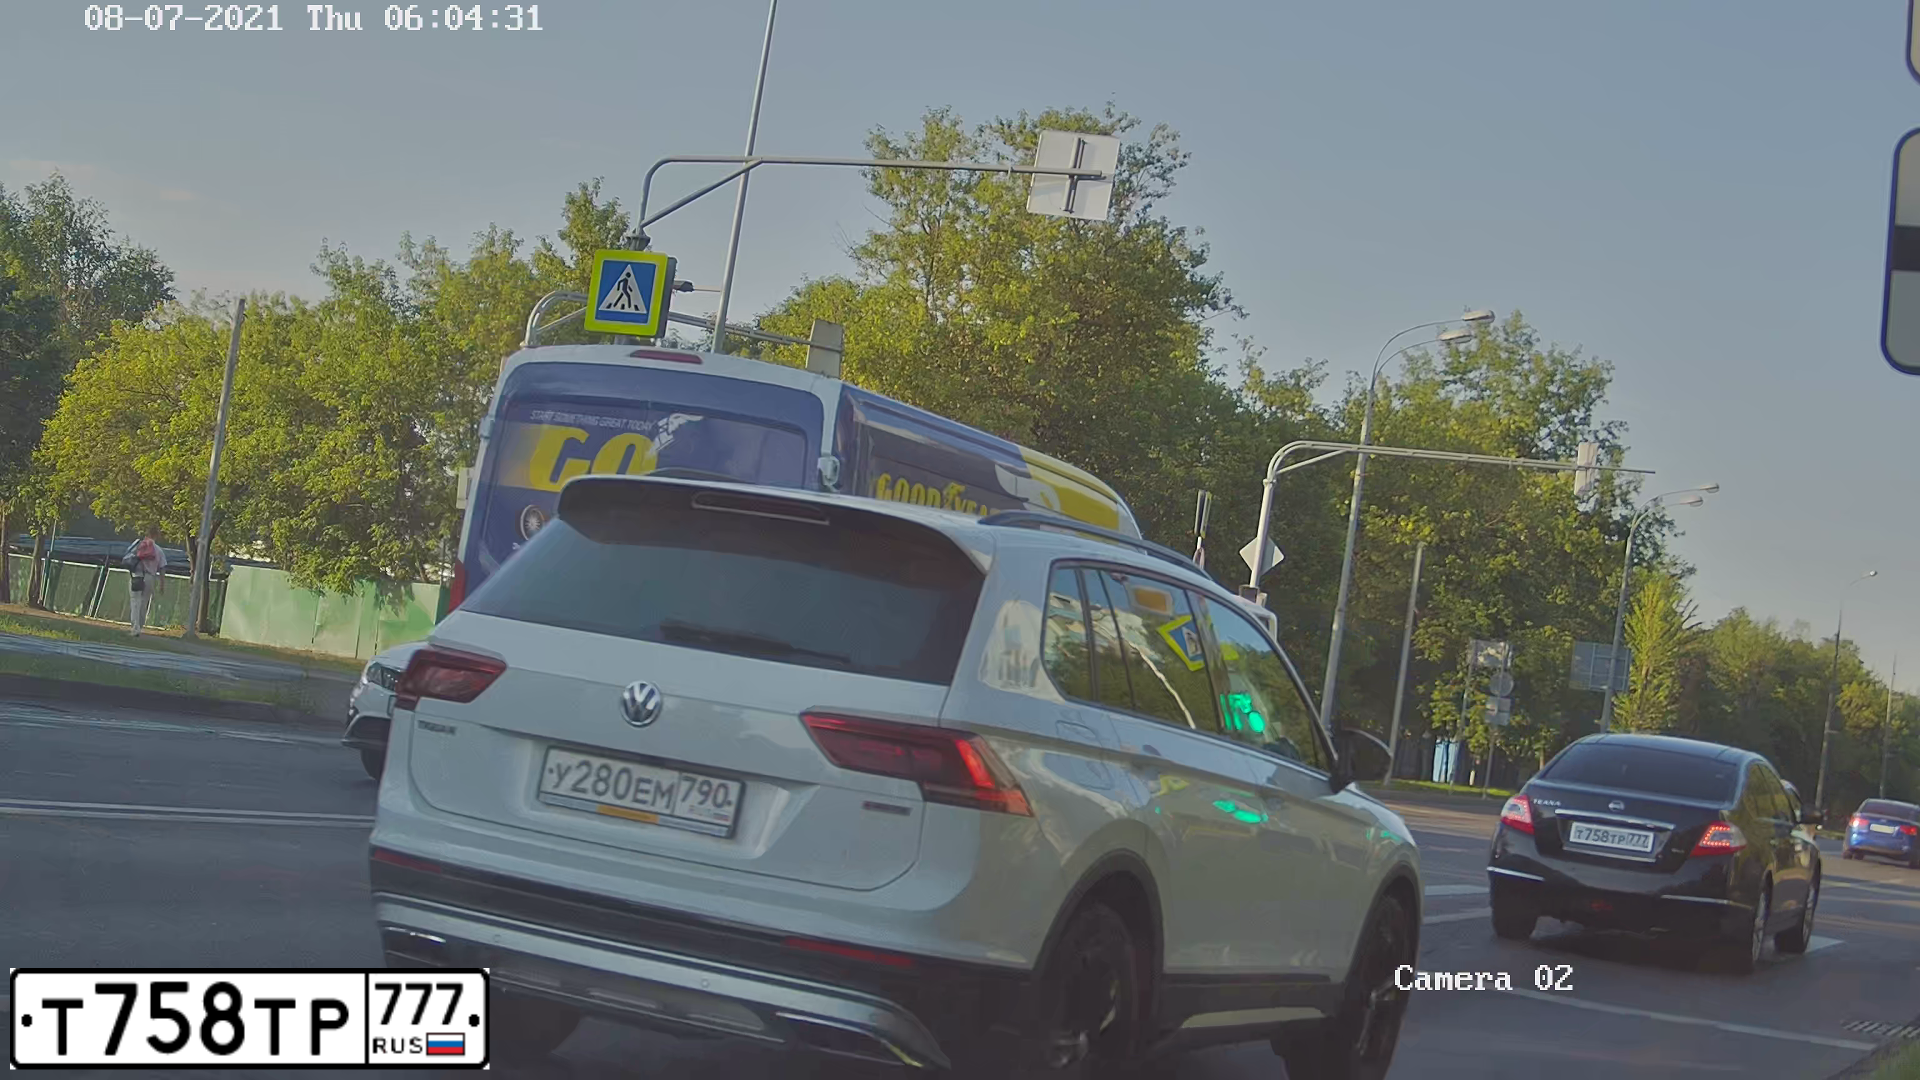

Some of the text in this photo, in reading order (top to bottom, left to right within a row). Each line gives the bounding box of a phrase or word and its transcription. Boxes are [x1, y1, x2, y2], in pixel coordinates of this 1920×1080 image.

[680, 774, 730, 810] 790
[1532, 798, 1562, 807] TEANA
[1628, 833, 1649, 846] 777
